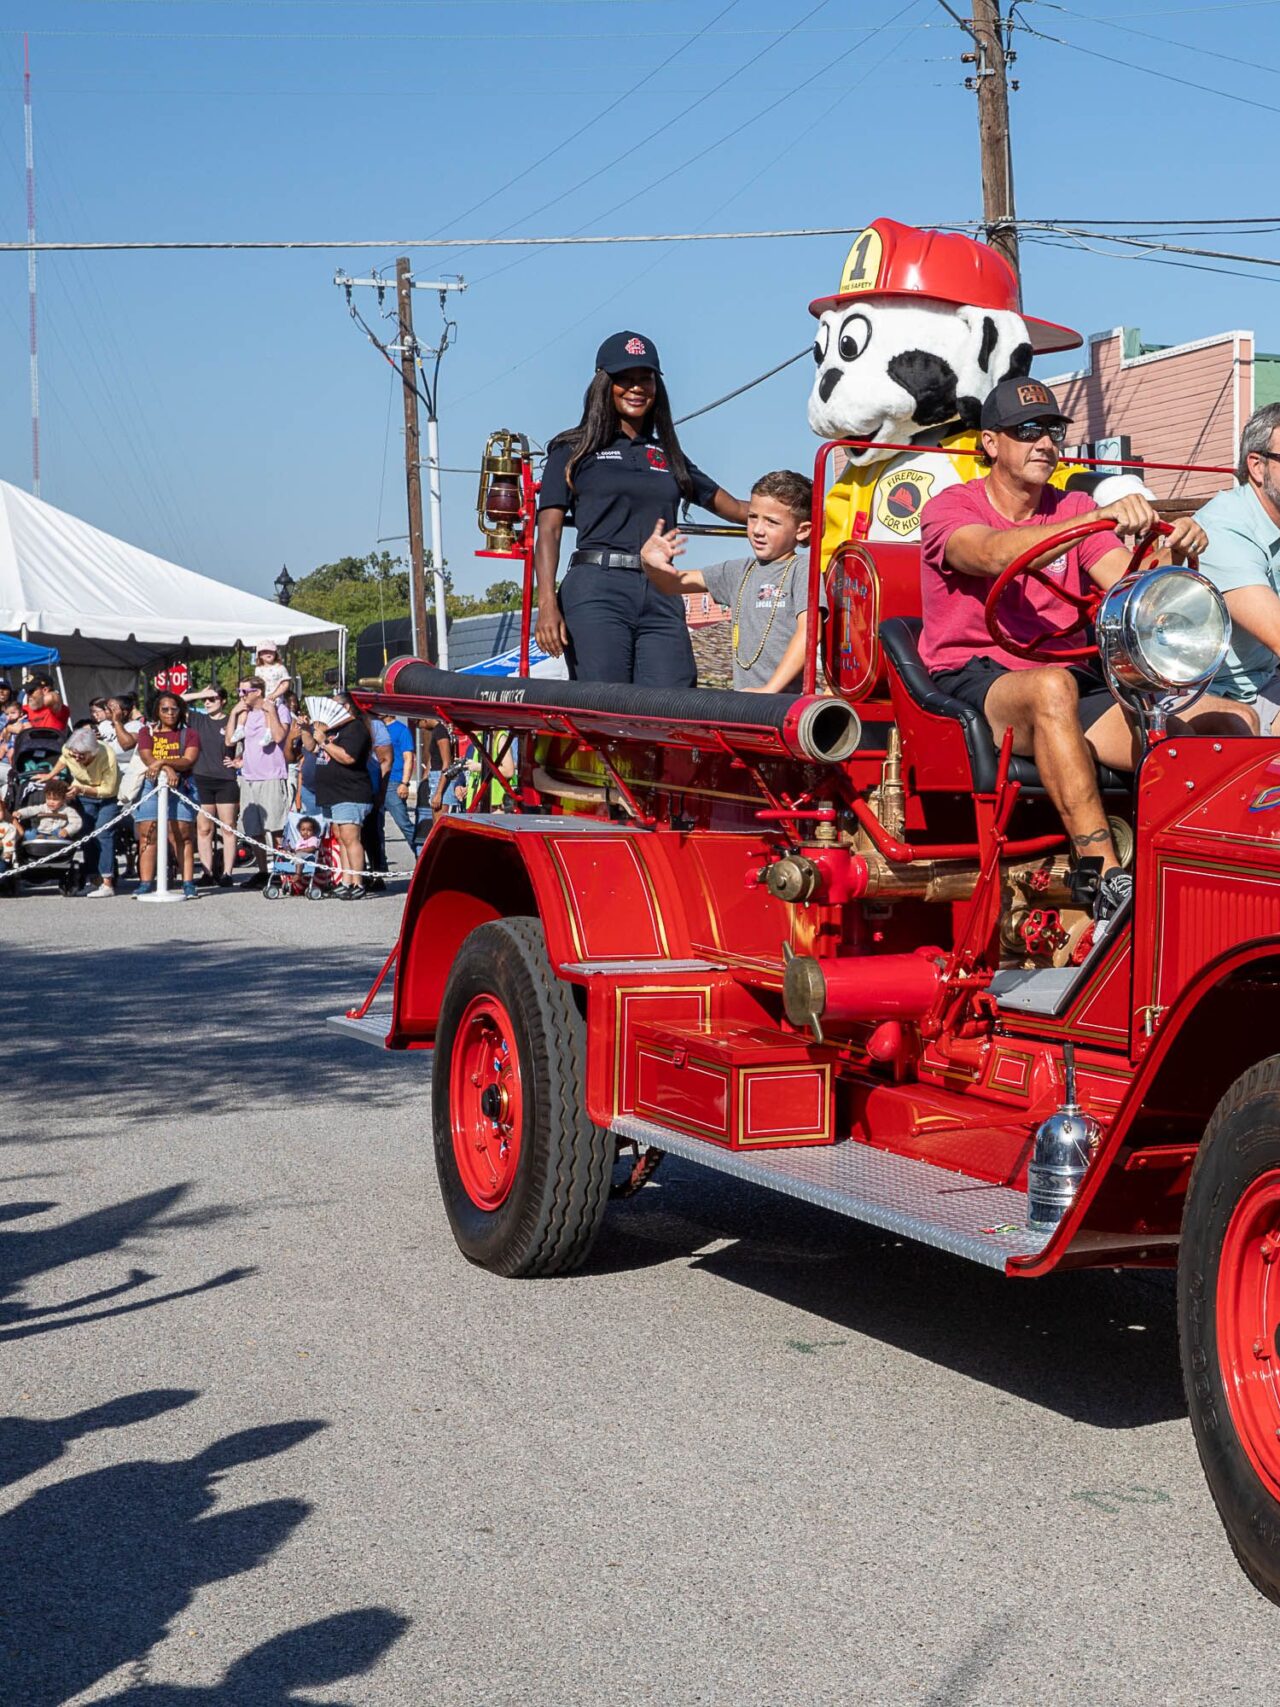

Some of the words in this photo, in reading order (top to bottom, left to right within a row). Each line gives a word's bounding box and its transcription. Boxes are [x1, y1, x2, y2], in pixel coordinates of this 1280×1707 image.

[849, 233, 872, 281] 1
[851, 281, 873, 290] SAFETY
[886, 471, 924, 488] FIREPUP
[883, 515, 901, 530] FOR
